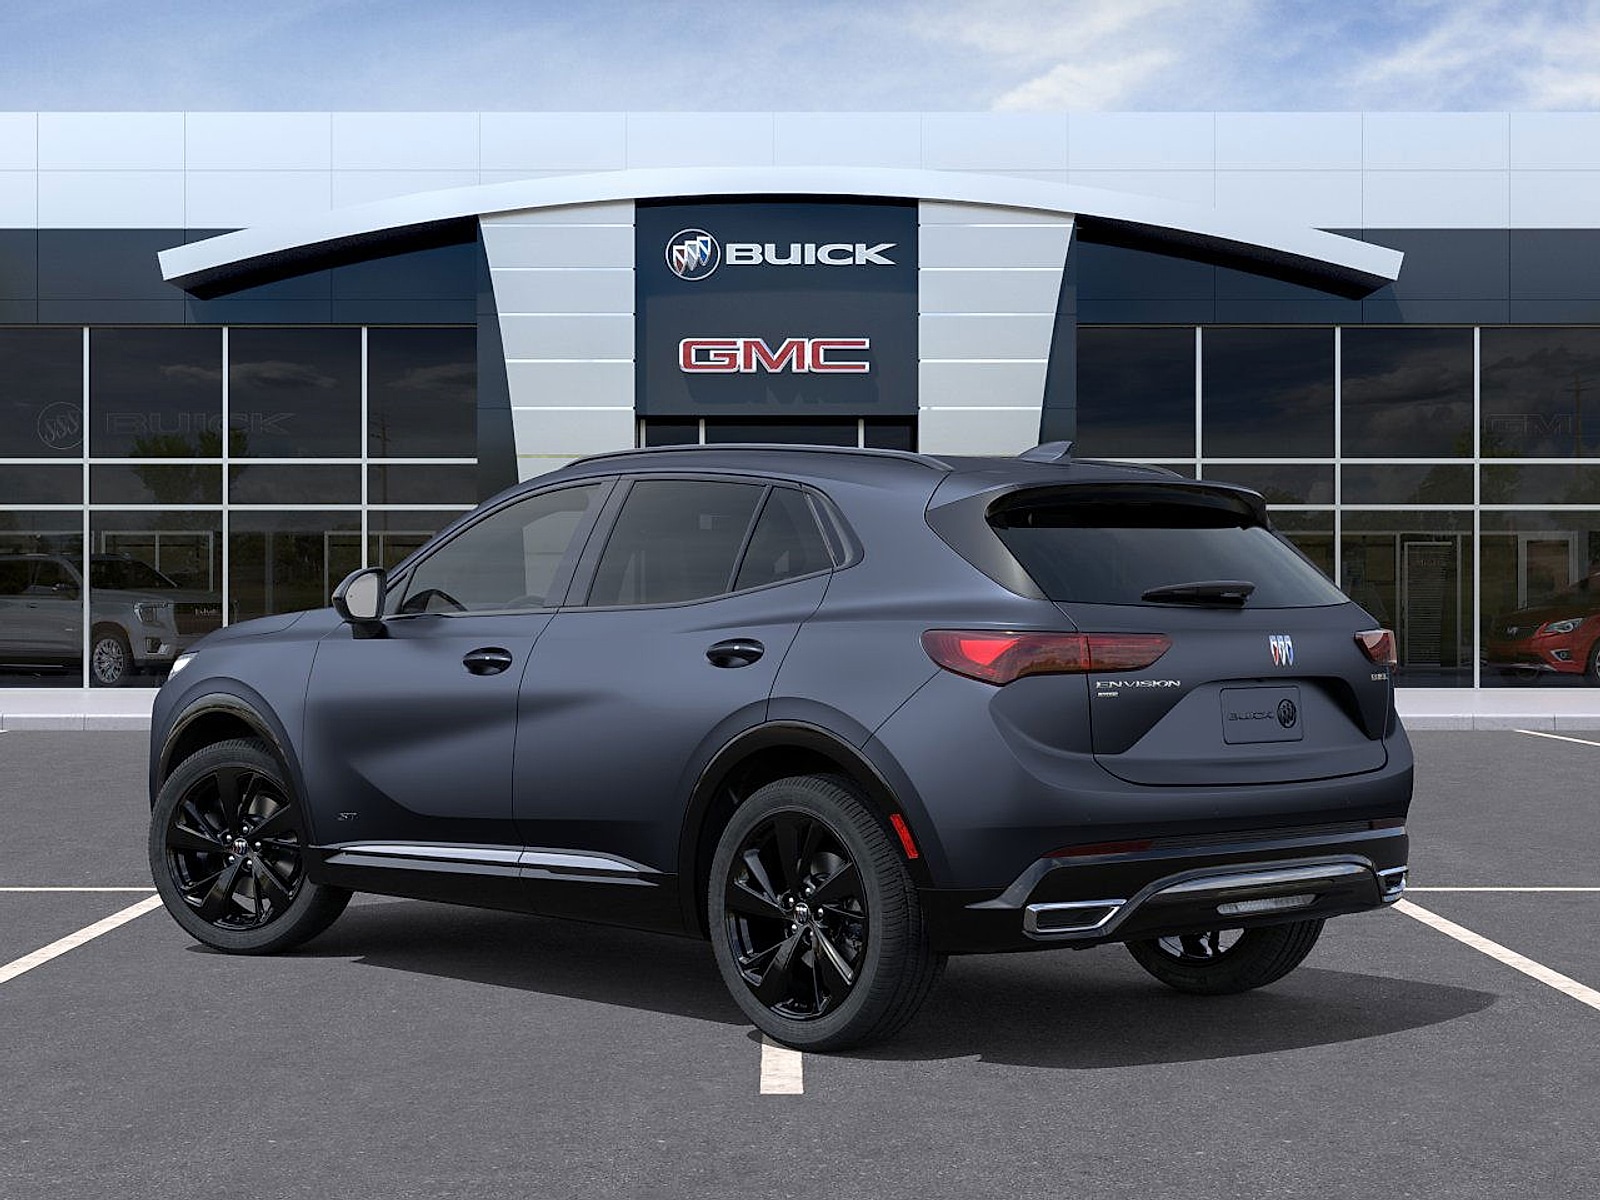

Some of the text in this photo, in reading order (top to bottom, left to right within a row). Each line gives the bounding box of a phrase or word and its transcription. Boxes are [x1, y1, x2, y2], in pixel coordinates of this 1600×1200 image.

[725, 243, 897, 265] BUICK
[679, 337, 870, 373] GMC
[106, 412, 296, 434] BUICK
[1096, 680, 1181, 689] ENVISION
[1228, 711, 1274, 721] BUICK
